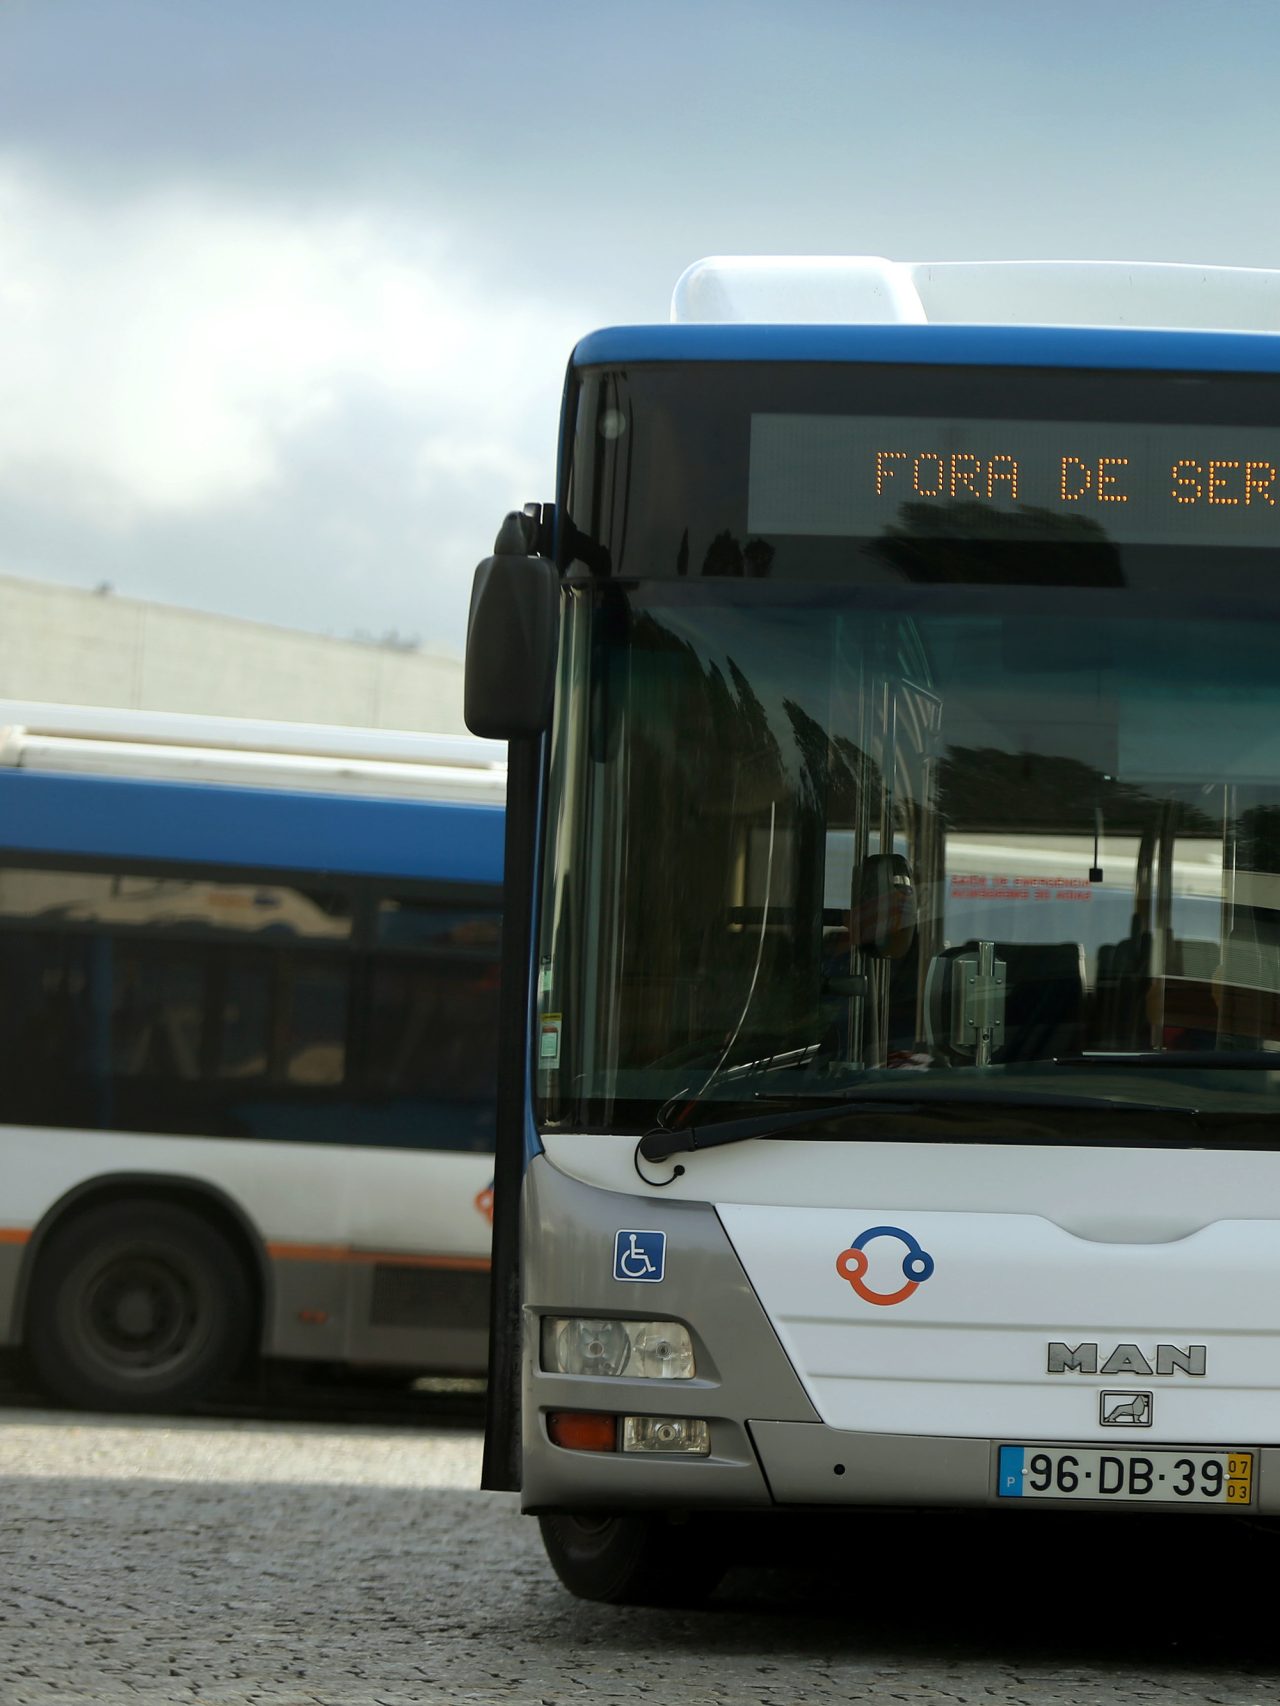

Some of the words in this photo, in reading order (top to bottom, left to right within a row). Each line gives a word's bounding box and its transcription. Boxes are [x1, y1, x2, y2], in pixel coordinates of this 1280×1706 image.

[876, 452, 1019, 499] FORA
[1061, 457, 1129, 502] DE
[1047, 1341, 1207, 1376] MAN
[1228, 1460, 1248, 1474] 07
[1007, 1476, 1015, 1487] P
[1227, 1485, 1247, 1499] 03
